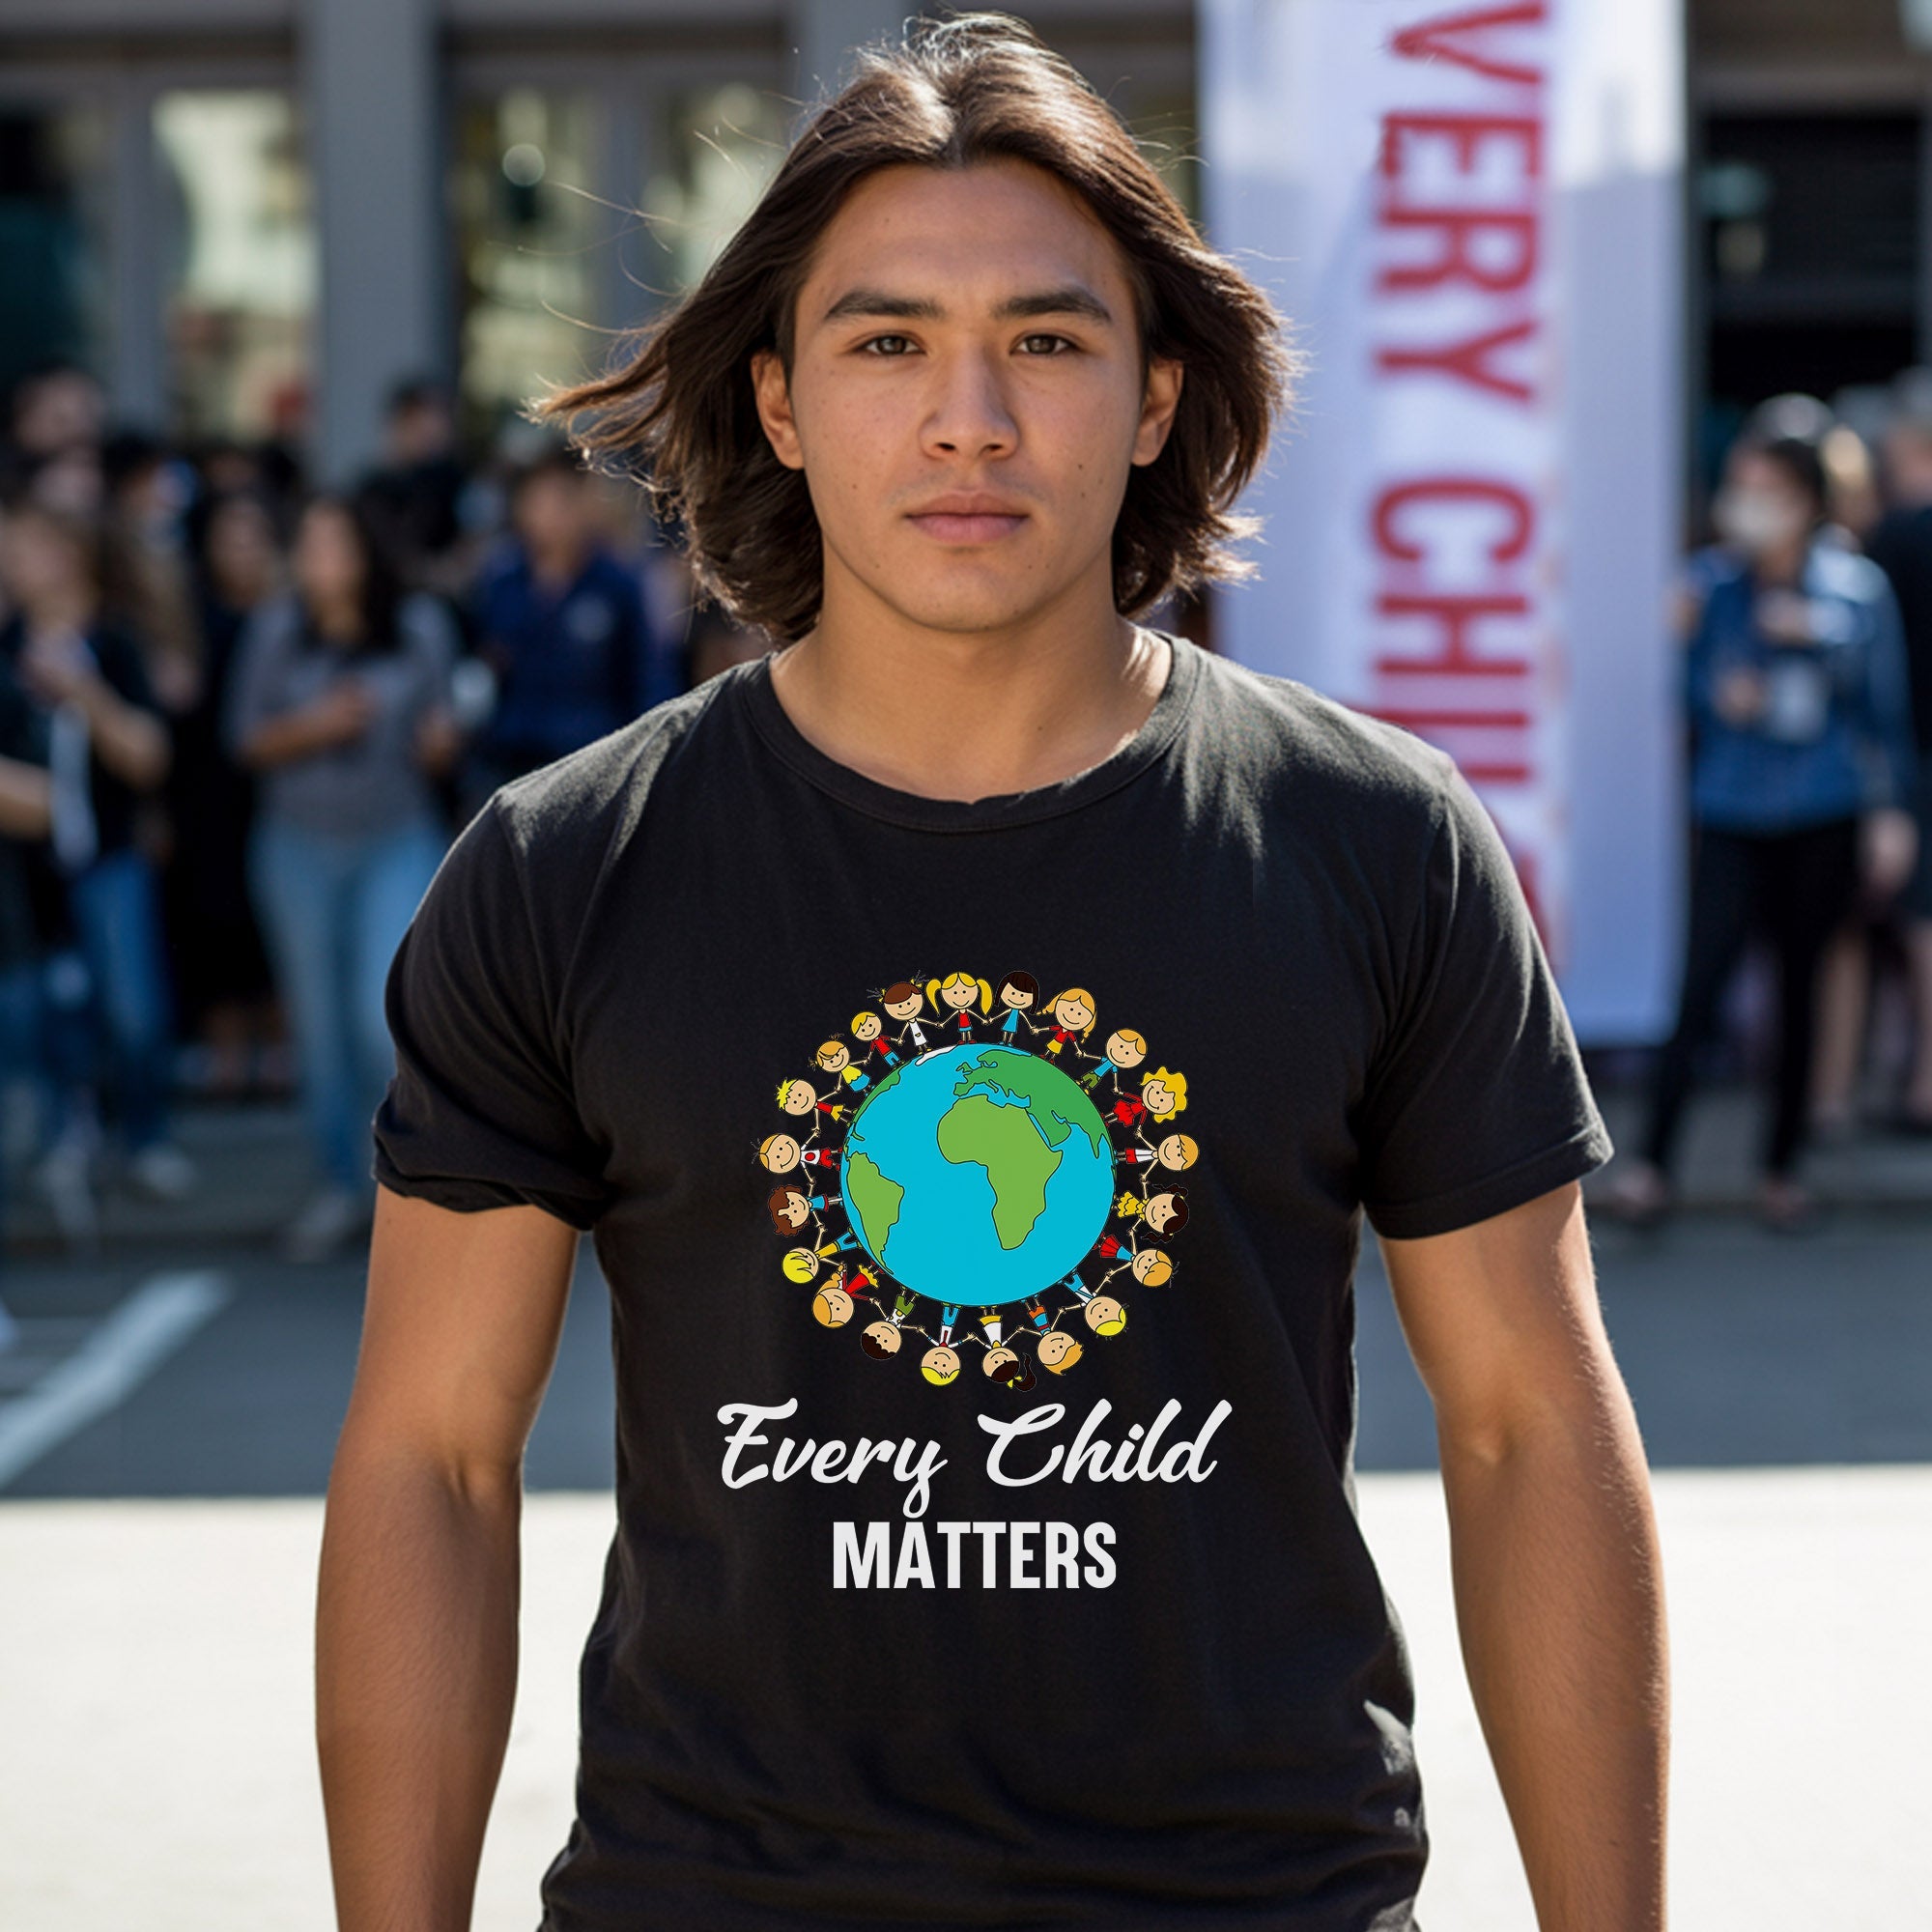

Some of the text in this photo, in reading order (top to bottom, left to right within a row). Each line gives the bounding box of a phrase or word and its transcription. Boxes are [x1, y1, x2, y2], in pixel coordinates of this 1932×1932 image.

[717, 1397, 1233, 1519] Every Child
[833, 1521, 1117, 1589] MATTERS
